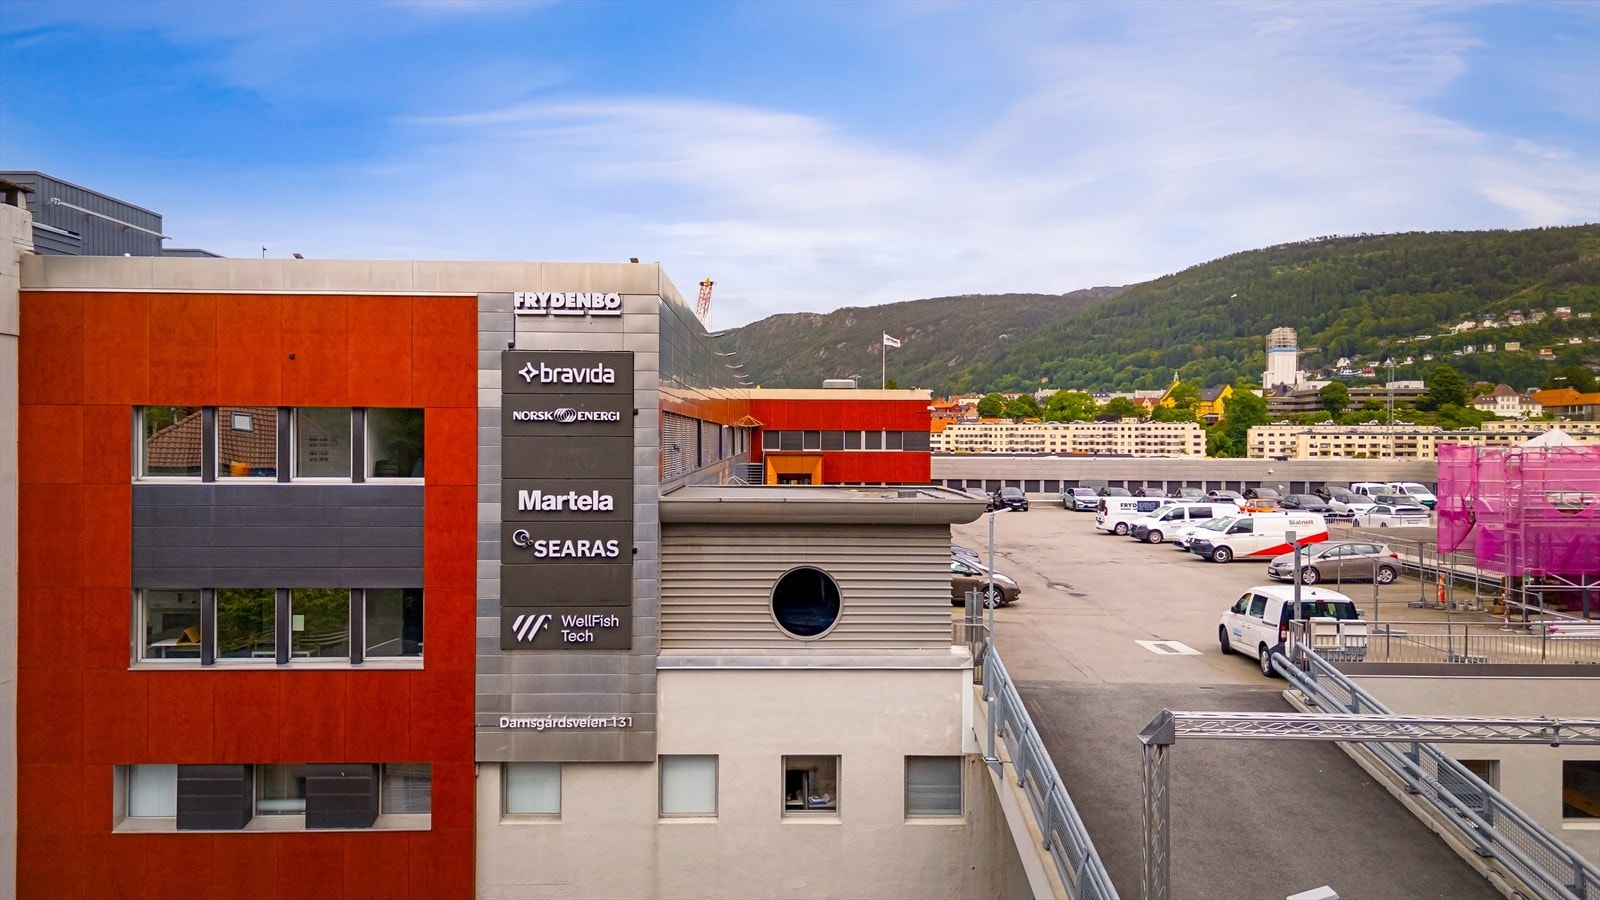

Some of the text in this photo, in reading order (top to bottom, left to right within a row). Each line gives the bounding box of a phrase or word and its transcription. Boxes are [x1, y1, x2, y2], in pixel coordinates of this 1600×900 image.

[514, 292, 621, 309] FRYDENBØ
[540, 362, 615, 384] bravida
[512, 411, 620, 421] NORSK ENERGI
[518, 490, 614, 511] Martela
[533, 539, 620, 558] SEARAS
[561, 614, 619, 627] WellFish
[561, 630, 594, 642] Tech
[499, 715, 633, 730] Damsgårdsveien 131
